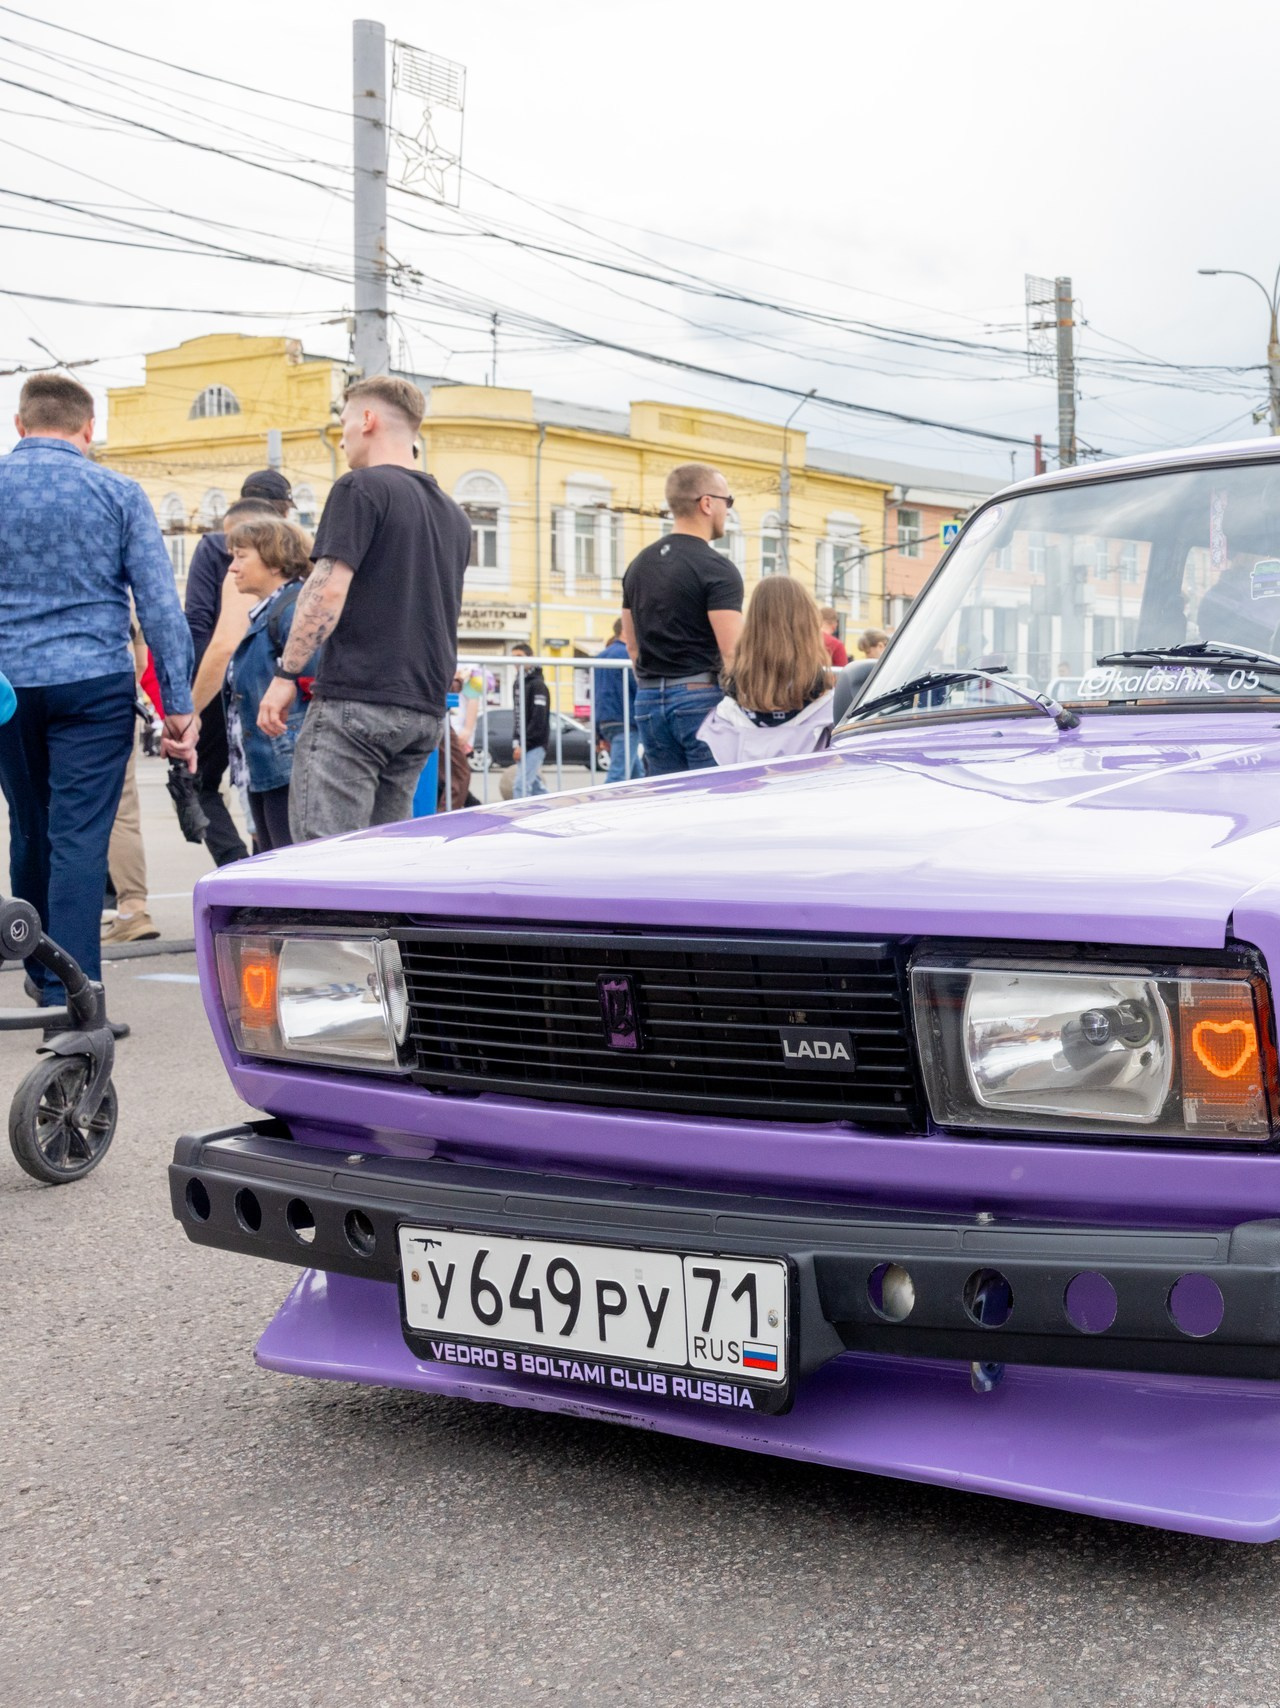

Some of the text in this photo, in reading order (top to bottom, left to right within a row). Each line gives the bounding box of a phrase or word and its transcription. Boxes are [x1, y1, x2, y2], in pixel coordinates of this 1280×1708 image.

[783, 1040, 850, 1060] LADA
[692, 1267, 758, 1338] 71
[694, 1336, 740, 1364] RUS
[430, 1342, 755, 1409] VEDRO S BOLTAMI CLUB RUSSIA
